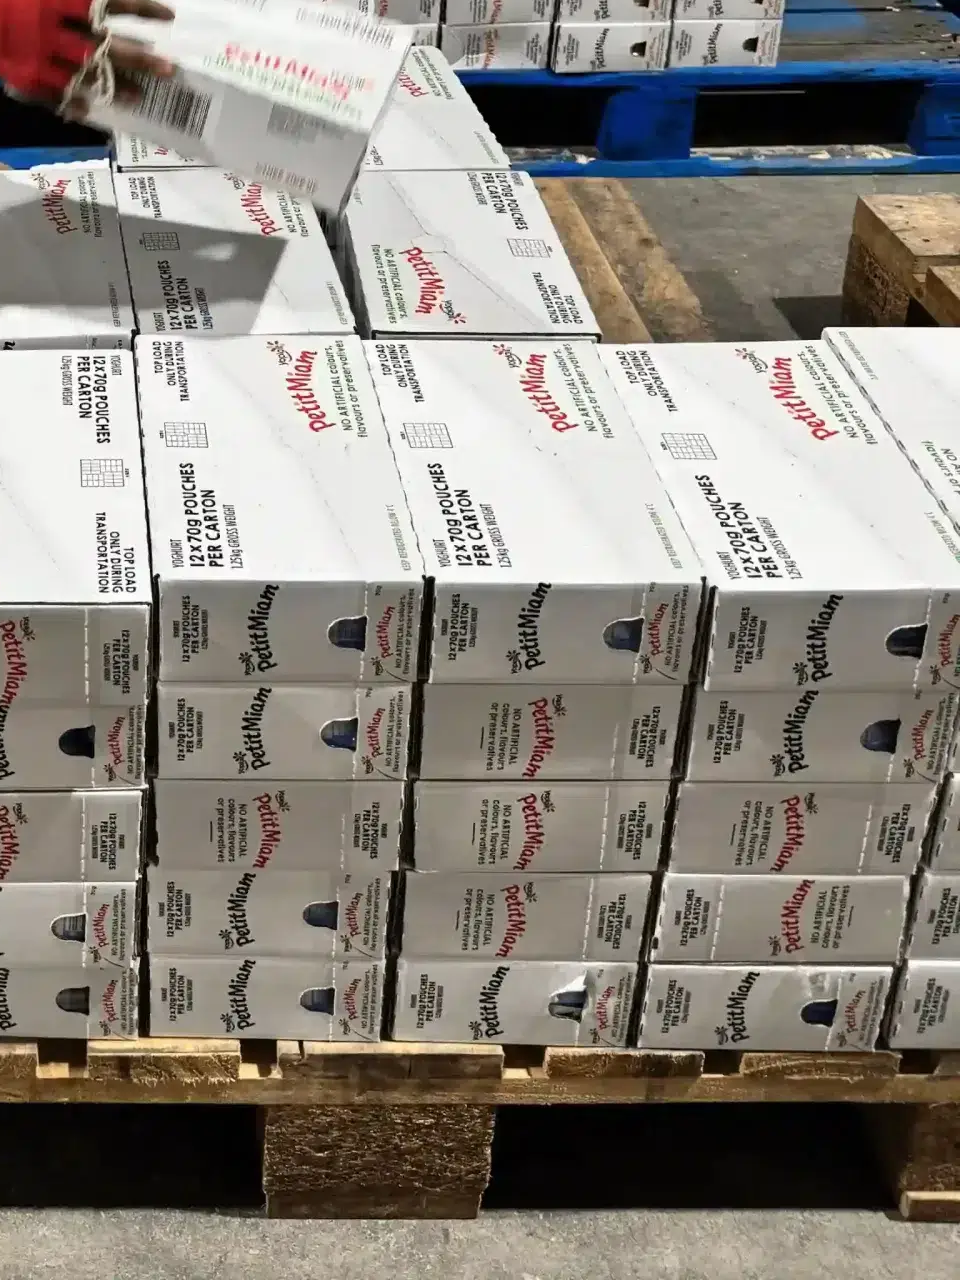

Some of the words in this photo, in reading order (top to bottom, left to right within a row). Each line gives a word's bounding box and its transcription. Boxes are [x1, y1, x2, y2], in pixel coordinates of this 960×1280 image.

[481, 172, 494, 188] PER
[147, 176, 162, 218] TRANSPORTATION
[487, 189, 508, 214] CARTON
[505, 200, 528, 230] POUCHES
[158, 260, 174, 297] POUCHES
[176, 278, 195, 314] CARTON
[531, 271, 560, 324] TRANSPORTATION
[185, 316, 198, 329] PER
[152, 341, 162, 359] LOAD
[163, 342, 174, 366] DURING
[77, 356, 90, 372] PER
[110, 355, 122, 375] YOGHURT
[154, 361, 163, 373] TOP
[166, 368, 176, 386] ONLY
[175, 341, 190, 401] TRANSPORTATION
[335, 340, 358, 392] preservatives
[397, 344, 425, 404] TRANSPORTATION
[62, 371, 72, 386] GROSS
[639, 350, 677, 412] TRANSPORTATION
[62, 387, 73, 405] WEIGHT
[78, 375, 92, 418] CARTON
[330, 377, 349, 416] ARTIFICIAL
[348, 394, 357, 402] or
[95, 396, 110, 443] POUCHES
[341, 419, 353, 431] NO
[352, 405, 368, 437] flavours
[941, 448, 957, 462] NO
[179, 462, 199, 515] POUCHES
[427, 463, 457, 515] POUCHES
[695, 475, 736, 528] POUCHES
[201, 490, 220, 540] CARTON
[223, 504, 237, 526] WEIGHT
[454, 490, 483, 540] CARTON
[727, 503, 767, 552] CARTON
[110, 532, 121, 555] ONLY
[226, 528, 240, 547] GROSS
[96, 512, 110, 593] TRANSPORTATION
[124, 547, 134, 564] TOP
[170, 539, 184, 568] YOGHURT
[207, 545, 224, 567] PER
[472, 545, 492, 566] PER
[110, 558, 123, 593] DURING
[125, 567, 136, 593] LOAD
[758, 557, 783, 578] PER
